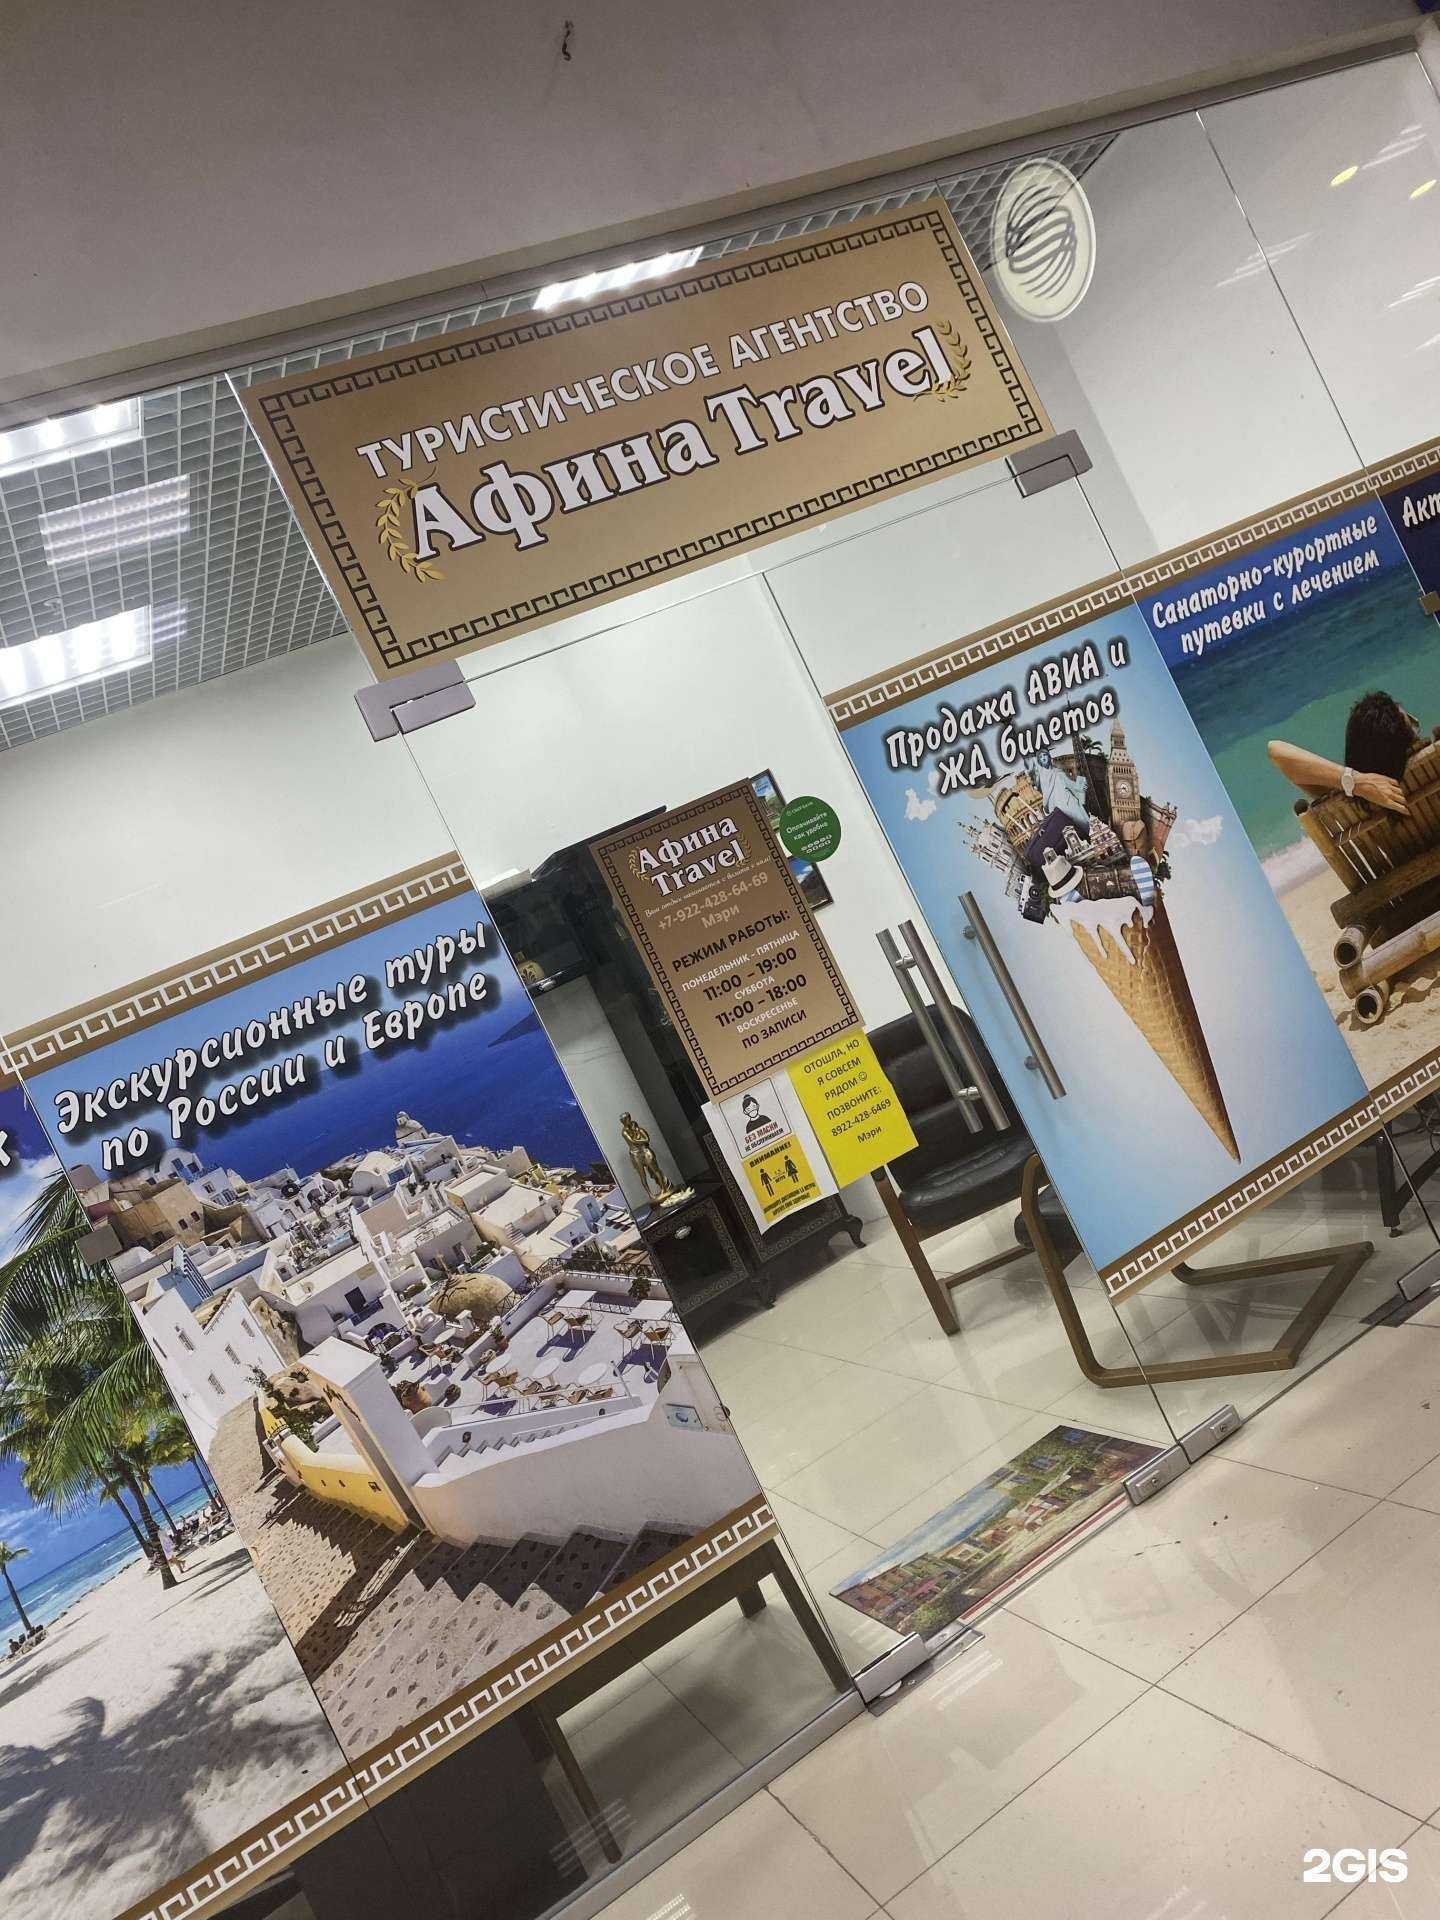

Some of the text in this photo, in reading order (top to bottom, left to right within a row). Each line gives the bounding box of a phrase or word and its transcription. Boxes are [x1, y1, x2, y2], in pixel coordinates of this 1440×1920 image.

[356, 281, 929, 480] ТУРИСТИЧЕСКОЕ АГЕНТСТВО
[411, 326, 955, 560] Афина Travel
[1152, 515, 1378, 629] Санаторно-курортные
[1181, 549, 1380, 655] путевки с лечением
[887, 642, 1126, 767] Продажа АВИА и
[938, 692, 1115, 795] ЖД билетов
[639, 817, 738, 873] Афина
[651, 839, 745, 896] Travel
[658, 871, 768, 930] +7-922-428-64-69
[701, 904, 740, 929] Мэри
[672, 910, 790, 972] РЕЖИМ РАБОТЫ:
[681, 953, 750, 991] ПОНЕДЕЛЬНИК
[756, 930, 800, 955] ПЯТНИЦА
[703, 974, 742, 1001] 11:00
[756, 947, 797, 975] 19:00
[715, 1000, 754, 1027] 11:00
[766, 974, 807, 1001] 18:00
[734, 975, 775, 1000] СУББОТА
[54, 921, 486, 1134] Экскурсионные туры
[736, 997, 799, 1033] ВОСКРЕСЕНЬЕ
[741, 1009, 807, 1049] ПО ЗАПИСИ
[102, 973, 487, 1171] по России и Европе
[804, 1039, 860, 1074] ОТОШЛА, НО
[817, 1057, 861, 1086] Я СОВСЕМ
[824, 1078, 858, 1100] РЯДОМ
[827, 1086, 882, 1120] ПОЗВОНИТЕ:
[831, 1098, 892, 1136] 8922-428-6469
[857, 1126, 882, 1143] Мэри
